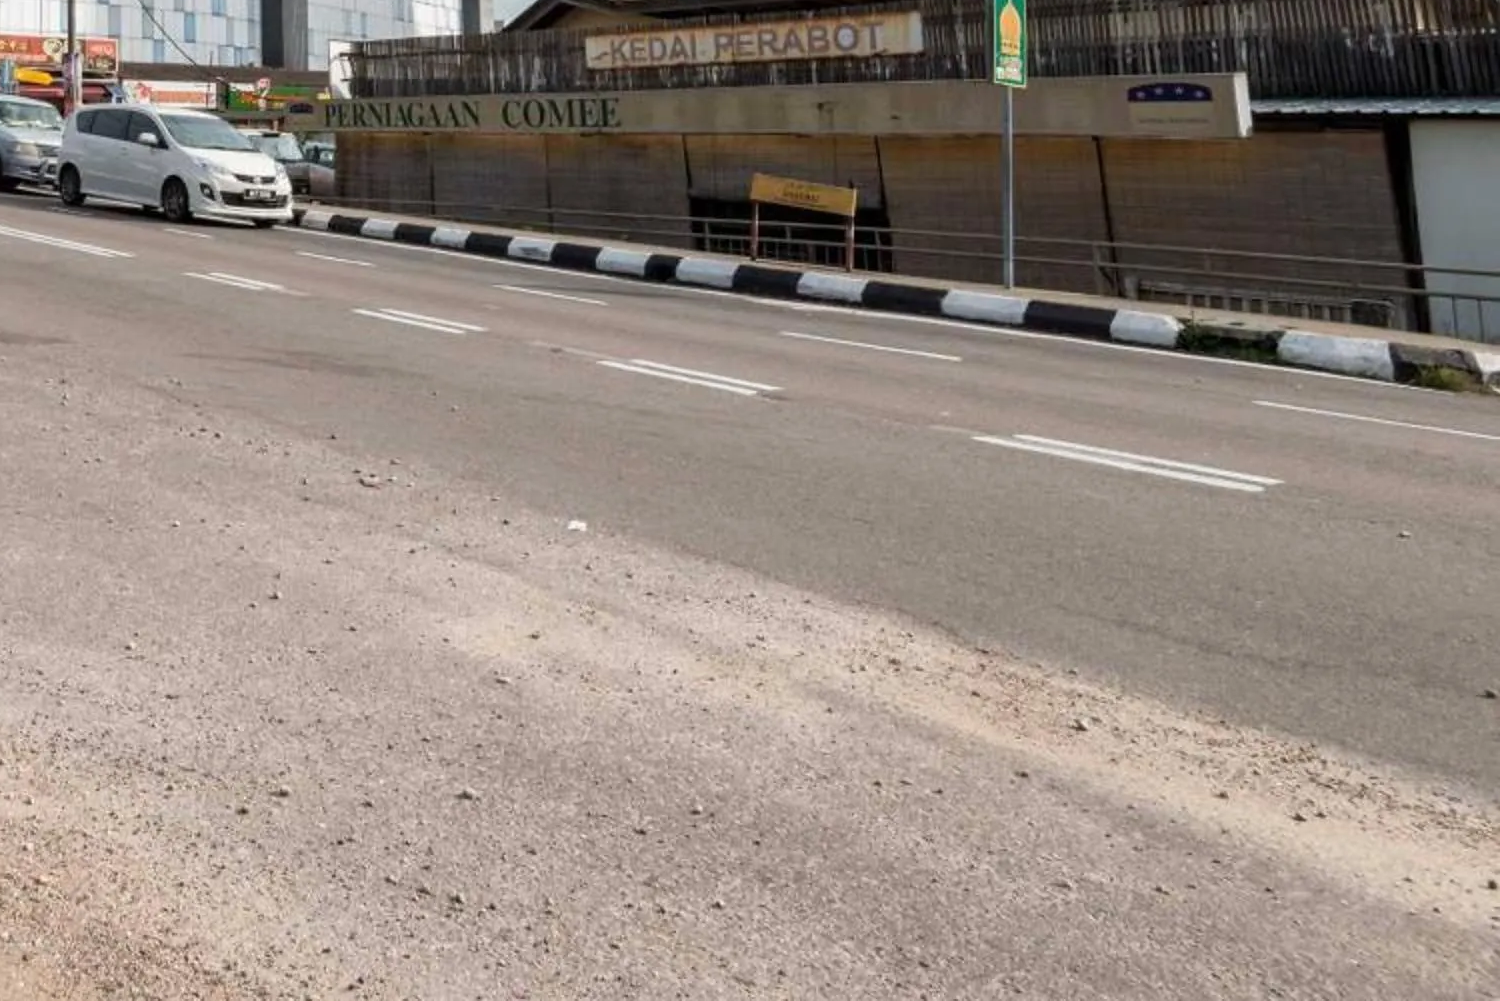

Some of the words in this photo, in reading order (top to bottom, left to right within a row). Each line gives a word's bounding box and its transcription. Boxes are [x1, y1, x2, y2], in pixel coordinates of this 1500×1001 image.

[609, 35, 697, 66] KEDAI
[713, 23, 886, 60] PERABOT
[324, 100, 481, 128] PERNIAGAAN
[501, 97, 622, 128] COMEE
